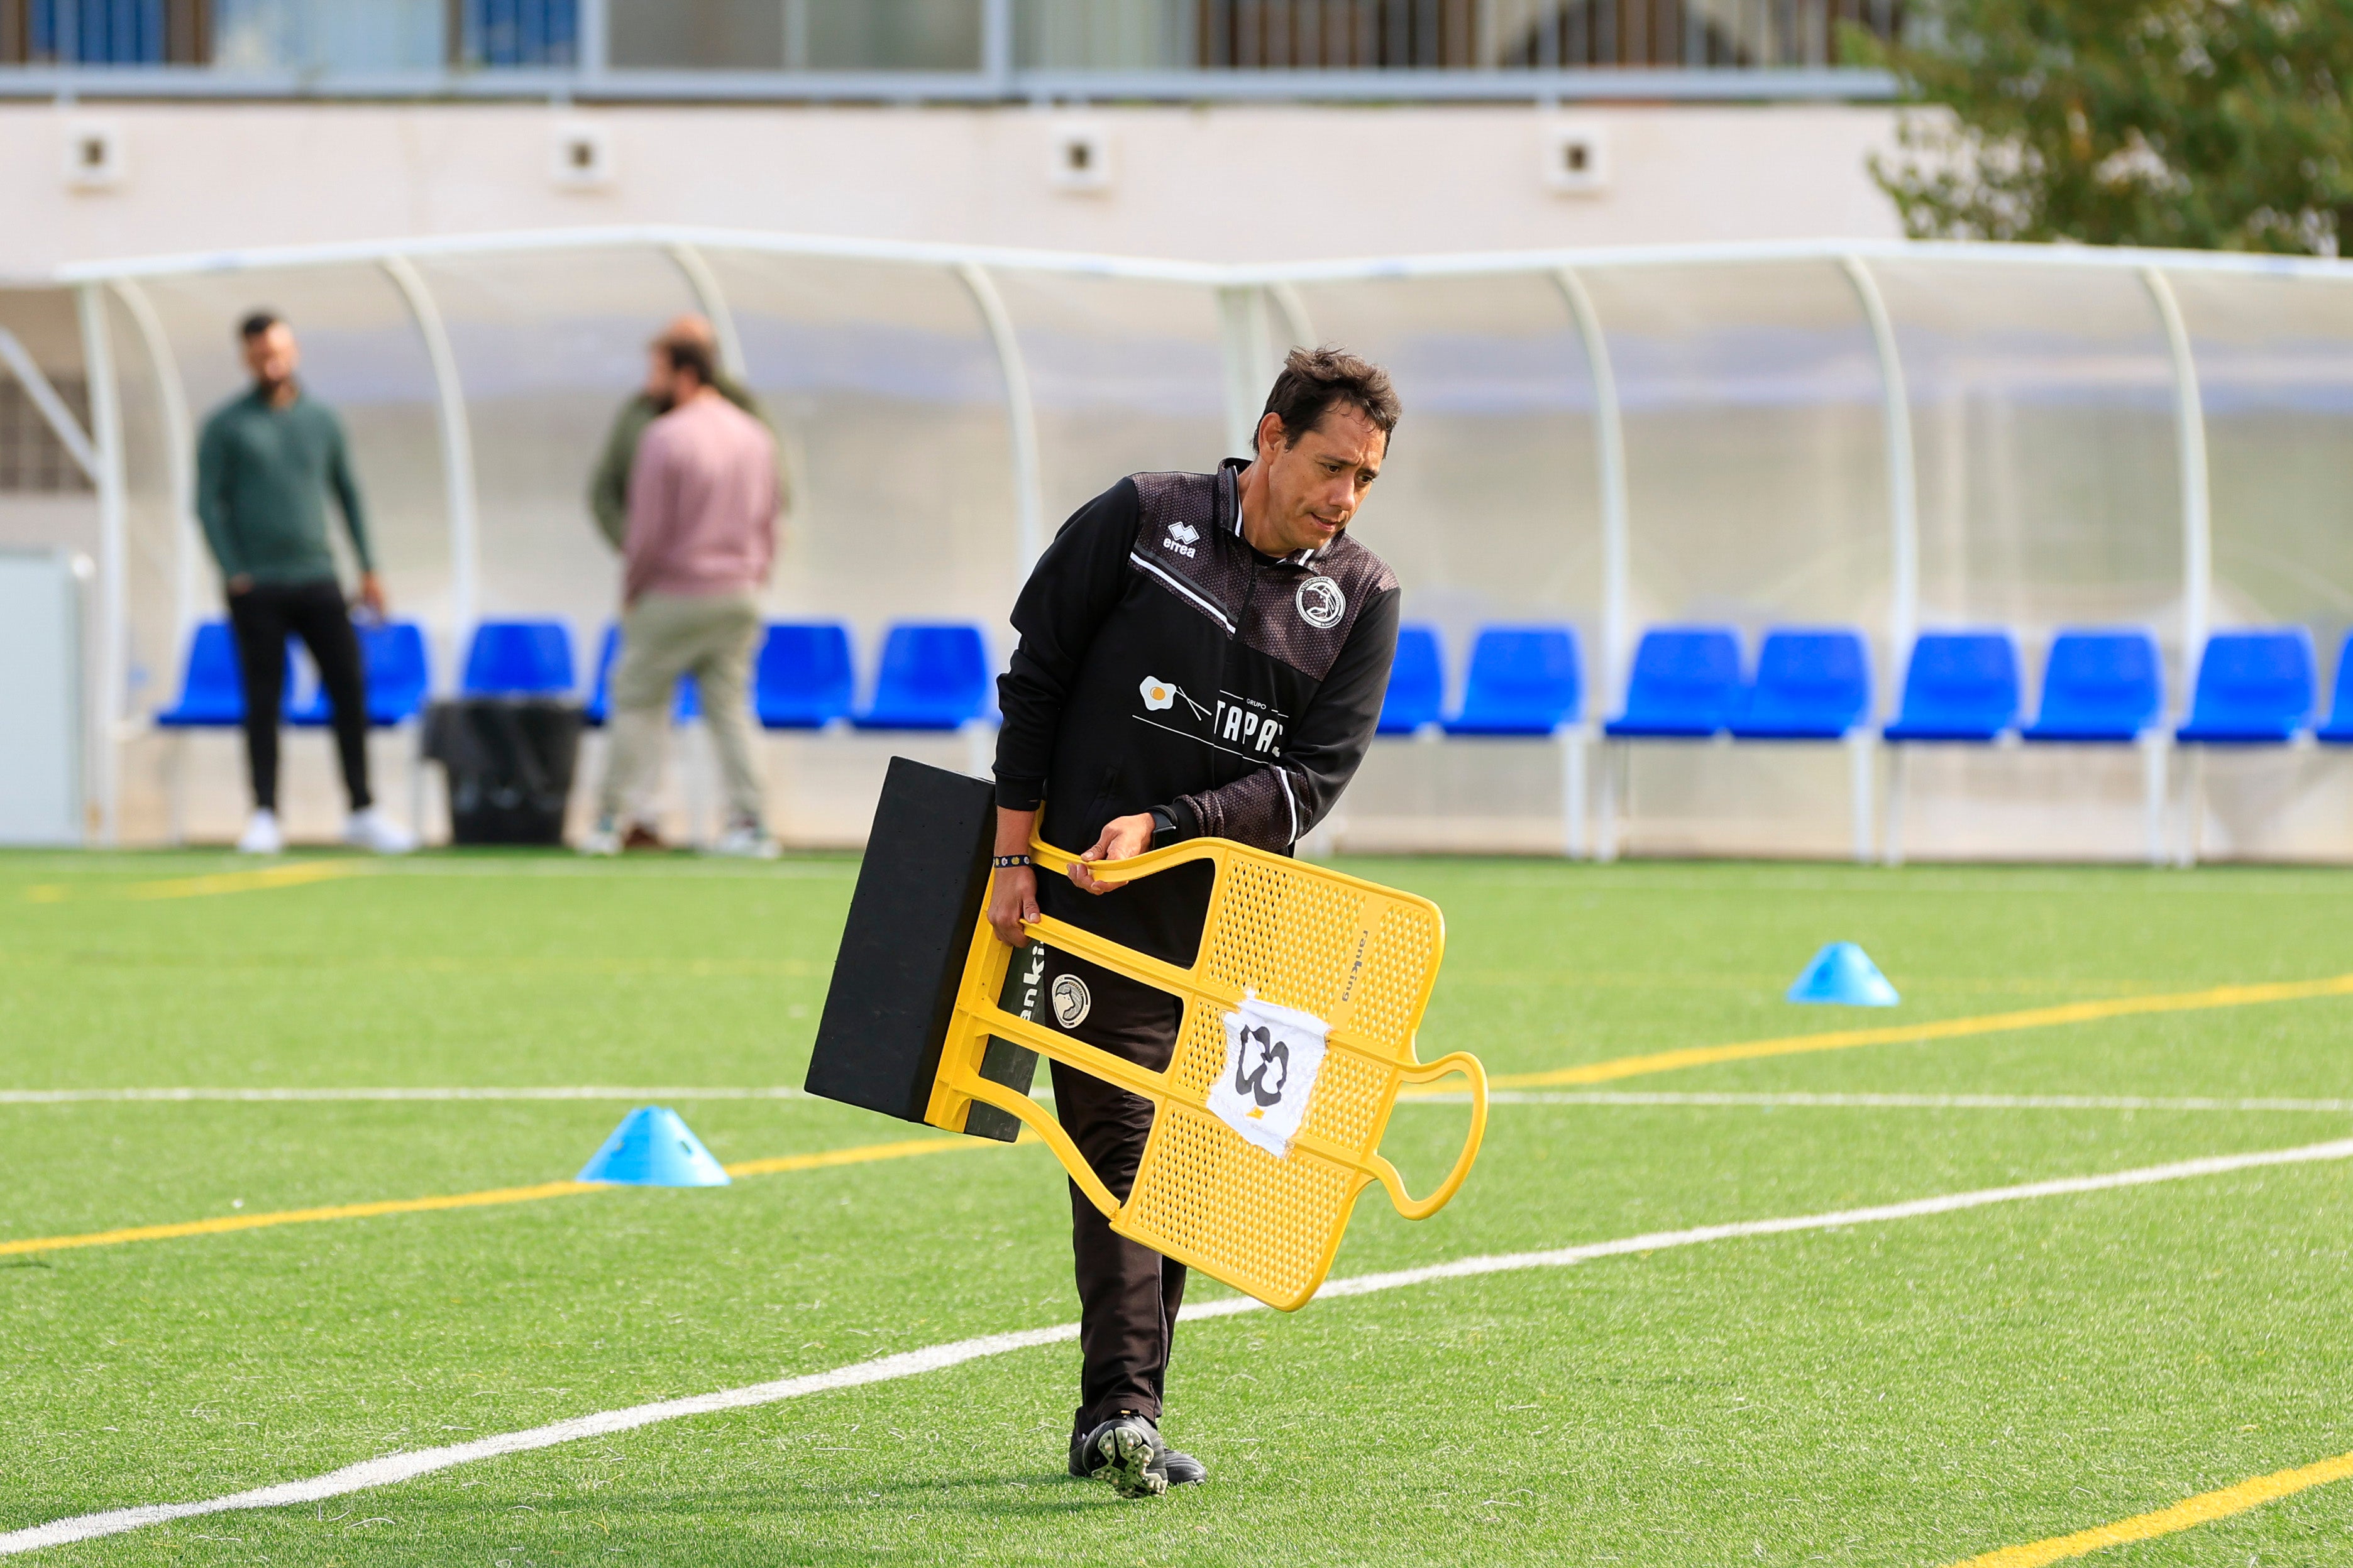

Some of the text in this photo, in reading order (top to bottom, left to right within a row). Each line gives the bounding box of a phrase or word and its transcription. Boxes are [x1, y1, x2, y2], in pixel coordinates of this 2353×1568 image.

[1246, 698, 1267, 710] GRUPO
[1020, 941, 1045, 1022] anki
[1342, 929, 1369, 1002] ranking
